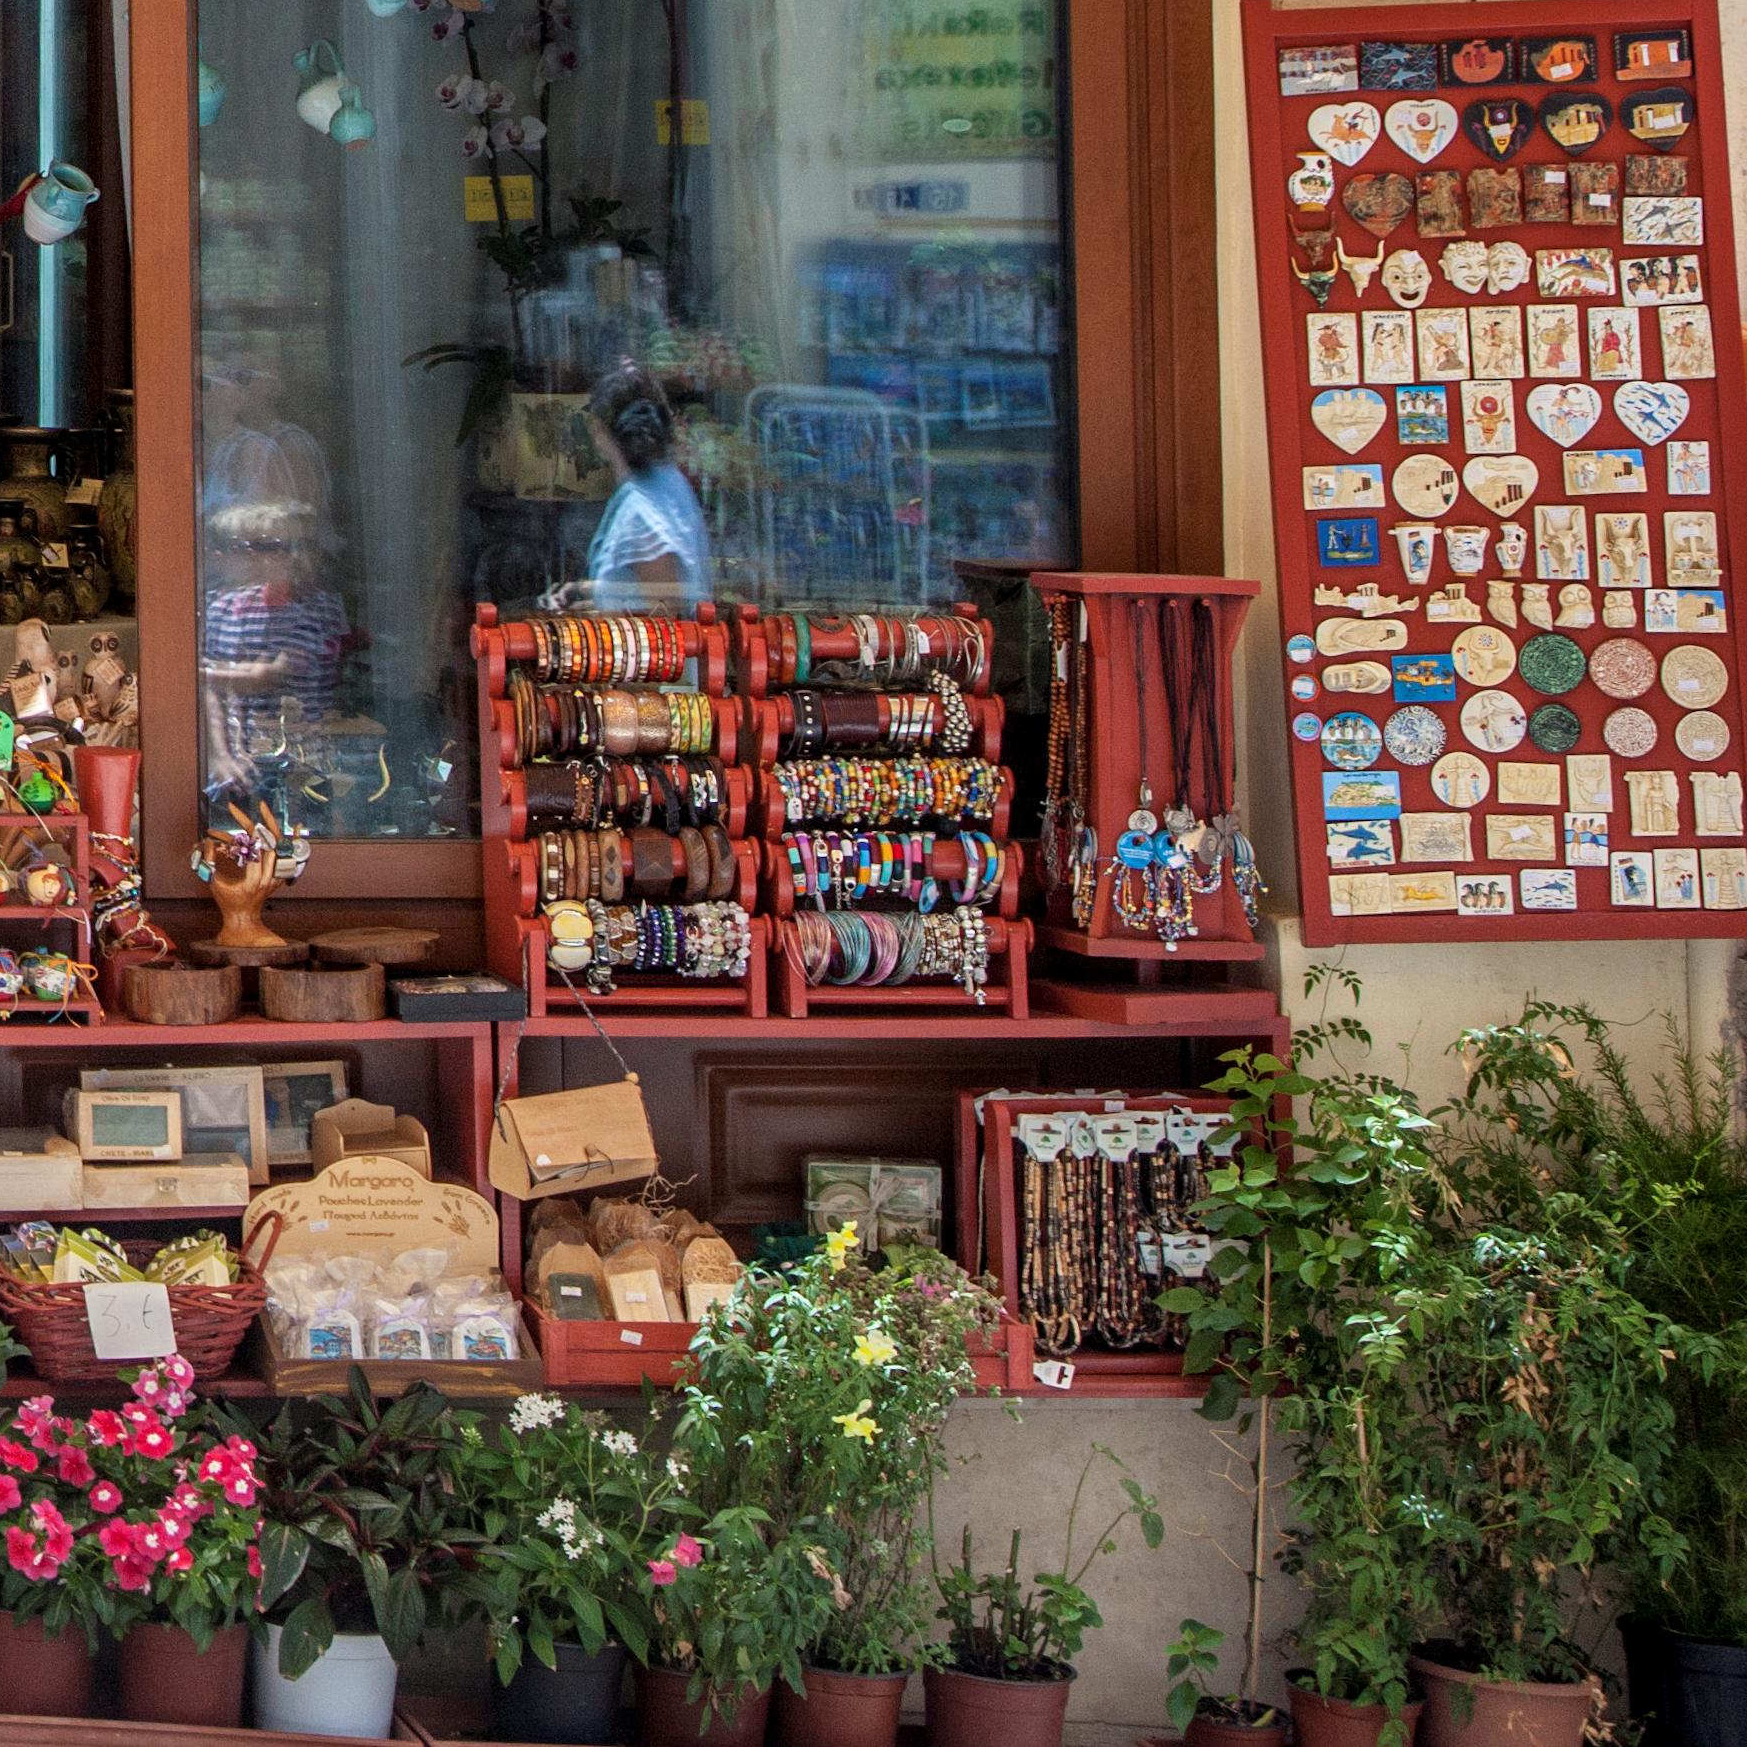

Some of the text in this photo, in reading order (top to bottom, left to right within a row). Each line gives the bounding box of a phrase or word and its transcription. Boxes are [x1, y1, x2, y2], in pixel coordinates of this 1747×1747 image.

[328, 1170, 414, 1192] Margaro
[318, 1196, 423, 1206] Pouches Lavender
